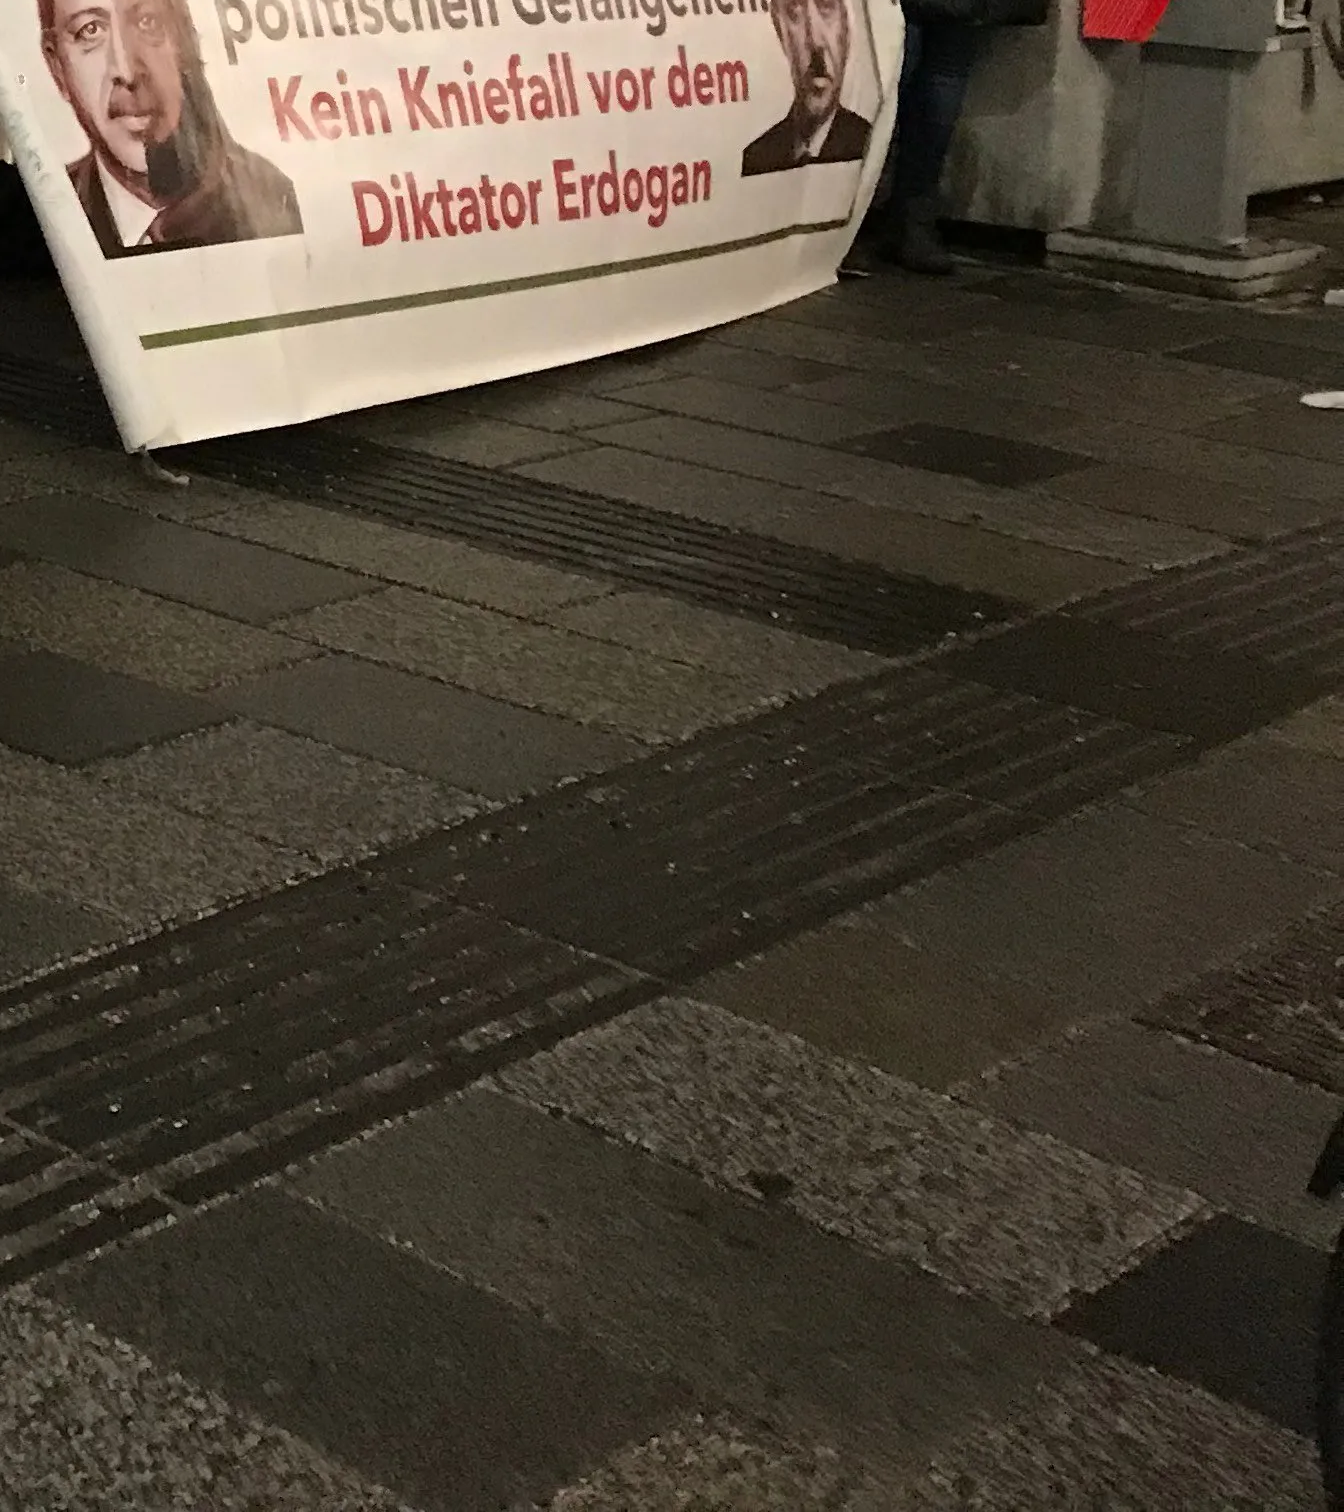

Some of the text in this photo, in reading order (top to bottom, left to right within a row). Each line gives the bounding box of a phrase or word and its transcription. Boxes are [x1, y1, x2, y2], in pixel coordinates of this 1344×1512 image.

[266, 44, 750, 142] Kein Kniefall vor dem
[351, 149, 712, 248] Diktator Erdogan
